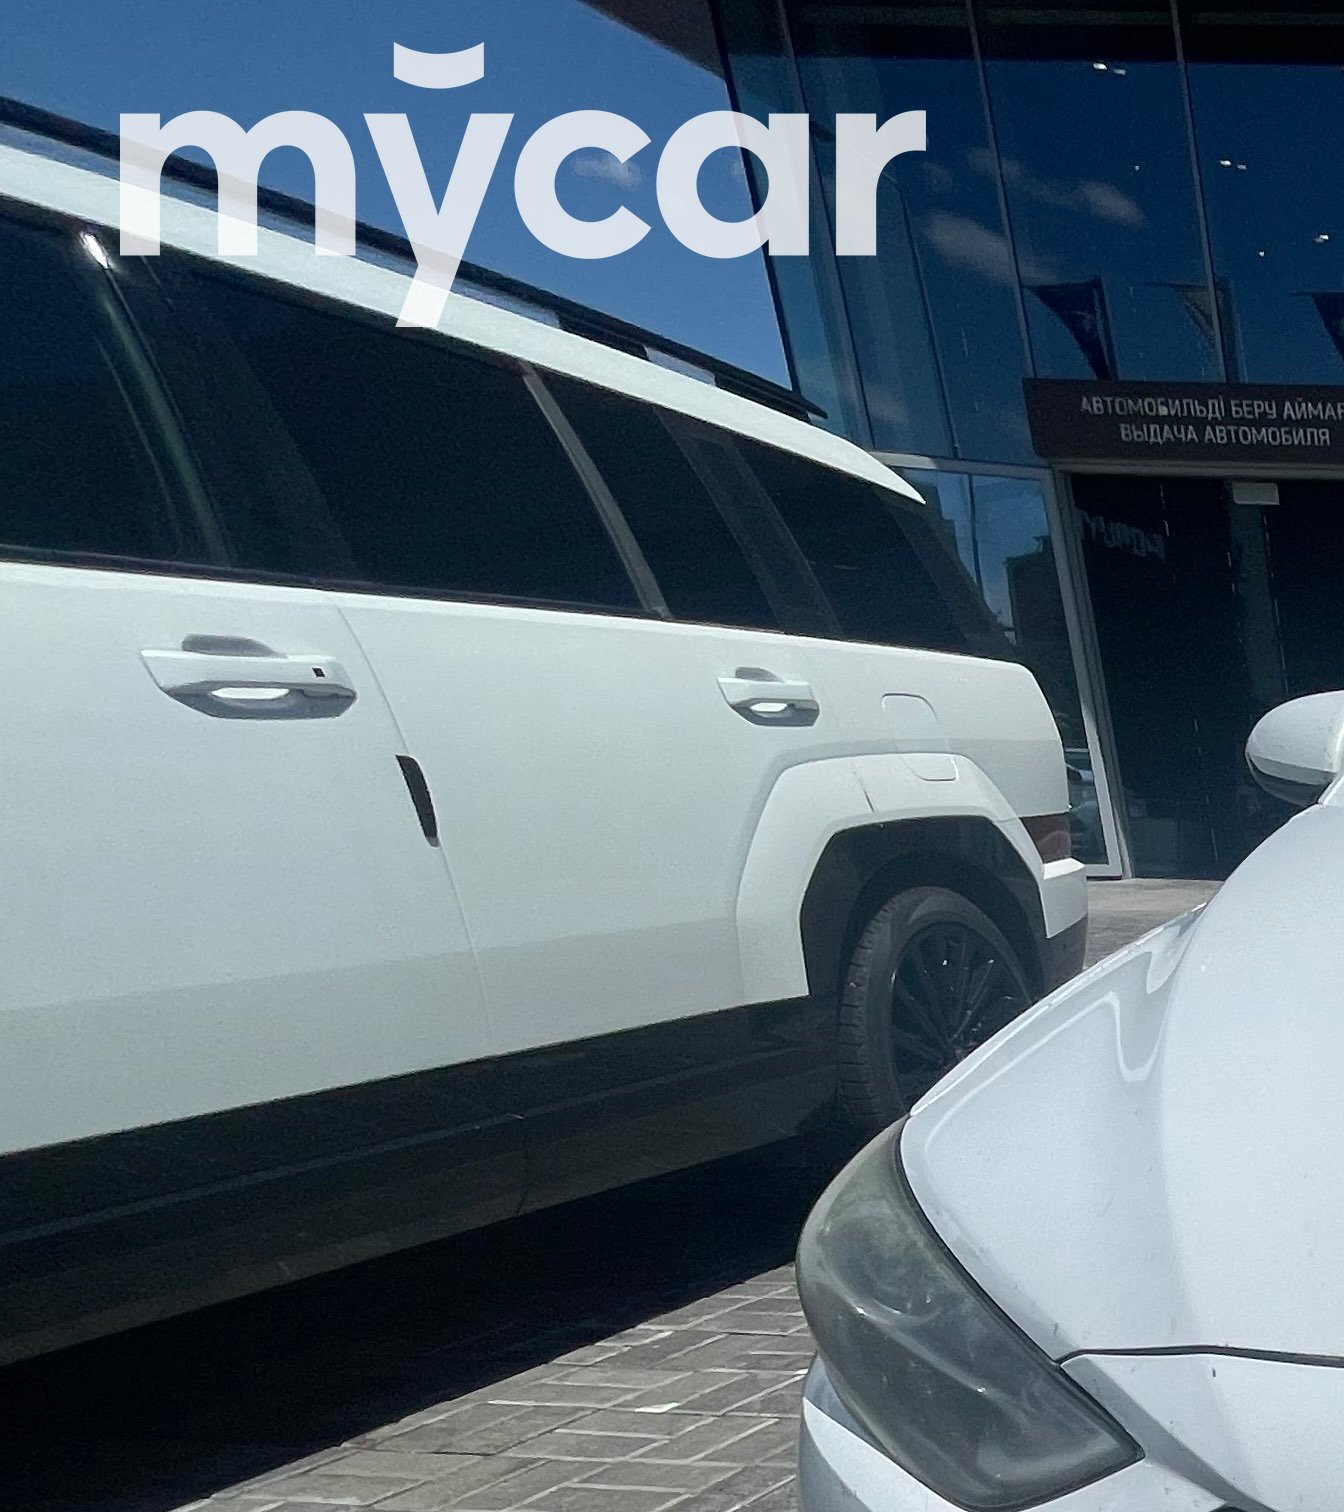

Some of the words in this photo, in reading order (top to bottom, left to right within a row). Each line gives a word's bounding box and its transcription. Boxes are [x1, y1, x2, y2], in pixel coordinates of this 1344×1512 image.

[1081, 395, 1226, 420] АВТОМОБИЛЬДІ
[1230, 399, 1277, 419] БЕРУ
[1120, 423, 1199, 445] ВЫДАЧА
[1204, 425, 1331, 446] АВТОМОБИЛЯ
